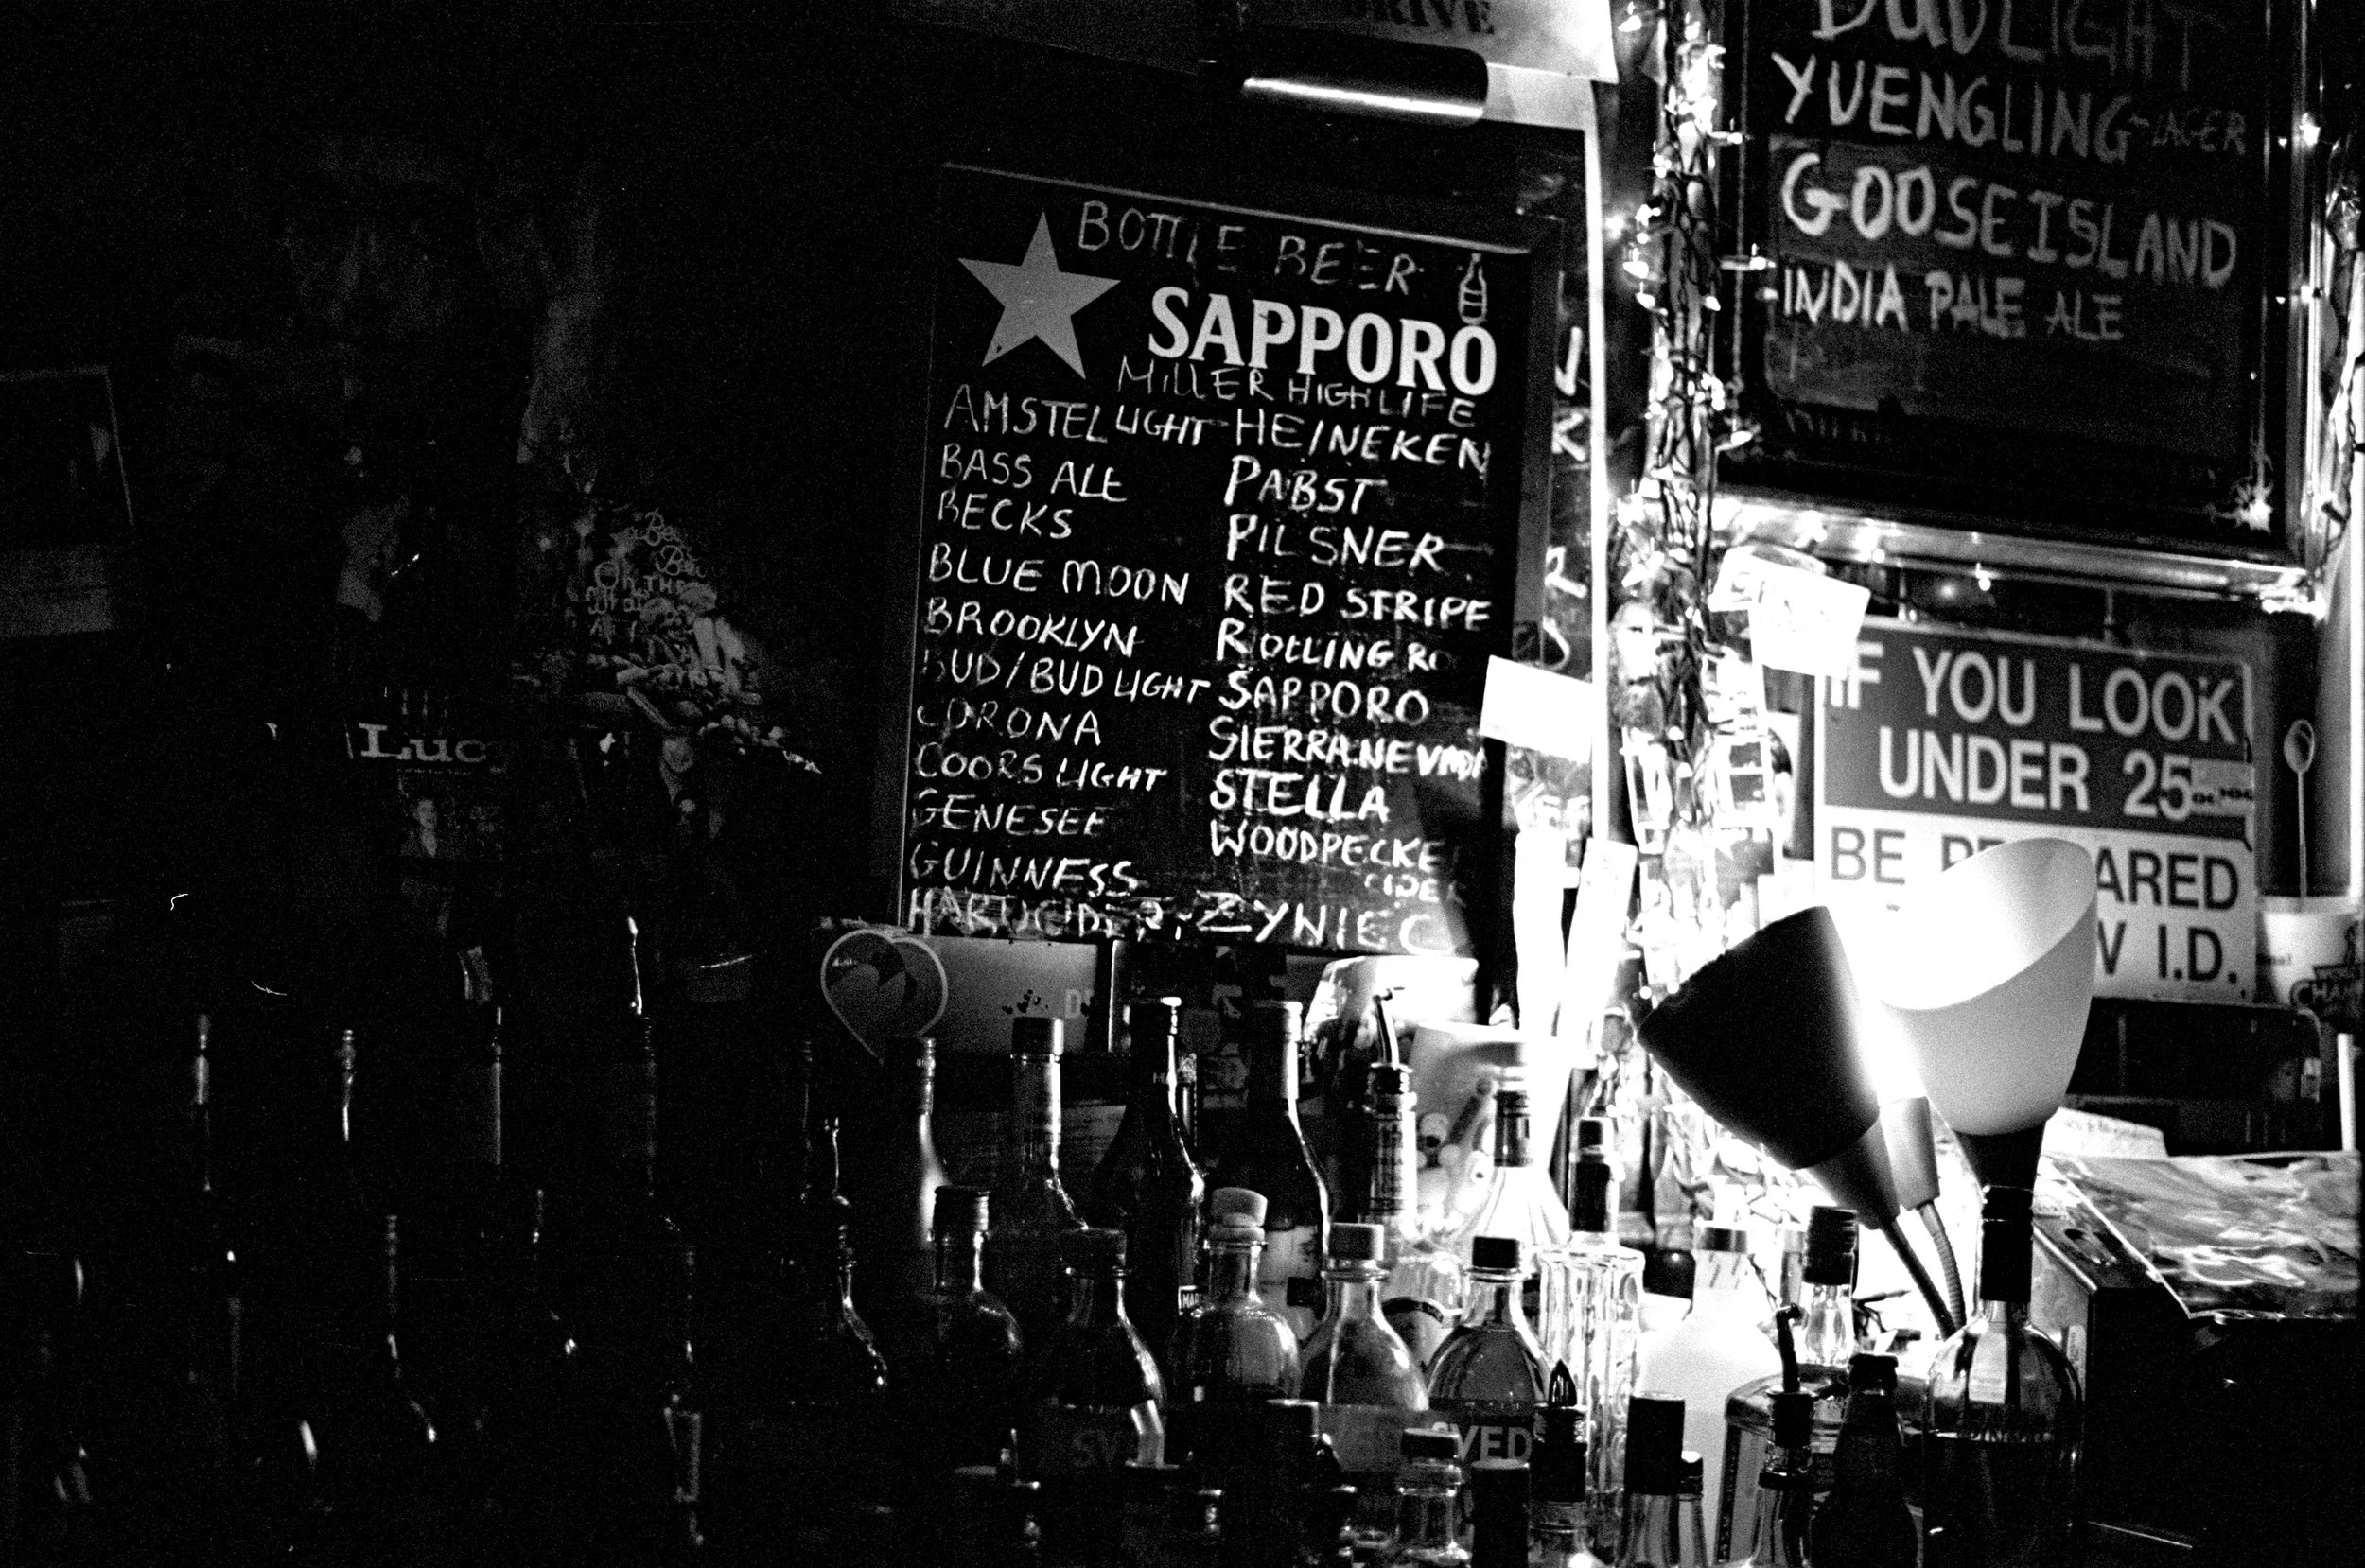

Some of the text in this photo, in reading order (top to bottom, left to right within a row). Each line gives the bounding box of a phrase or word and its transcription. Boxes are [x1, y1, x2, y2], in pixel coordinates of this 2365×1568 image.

[1771, 52, 2131, 163] YUENGLING
[1784, 260, 2125, 340] INDIA PALE ALE
[1147, 287, 1497, 395] SAPPORO
[944, 384, 1206, 446] AMSTEL LIGHT
[1236, 408, 1492, 478] HEINEKEN
[940, 444, 1128, 502] BASS ALE
[1223, 454, 1389, 514] PABST
[937, 489, 1074, 539] BECKS
[1227, 514, 1445, 573] PILSNER
[929, 542, 1189, 605] BLUE MOON
[1225, 573, 1492, 632] RED STRIPE
[924, 596, 1137, 658] BROOKLYN
[1216, 618, 1394, 671] ROLLING
[1114, 668, 1211, 704] LIGHT
[1218, 669, 1429, 726] SAPPORO
[1912, 646, 2036, 727] YOU
[2069, 661, 2238, 745] LOOK
[916, 742, 1168, 792] COORS LIGHT
[1209, 767, 1390, 824] STELLA
[1878, 724, 2192, 821] UNDER 25
[910, 842, 1139, 899] GUINNESS
[1830, 826, 1906, 885] BE
[2156, 922, 2238, 984] I.D.
